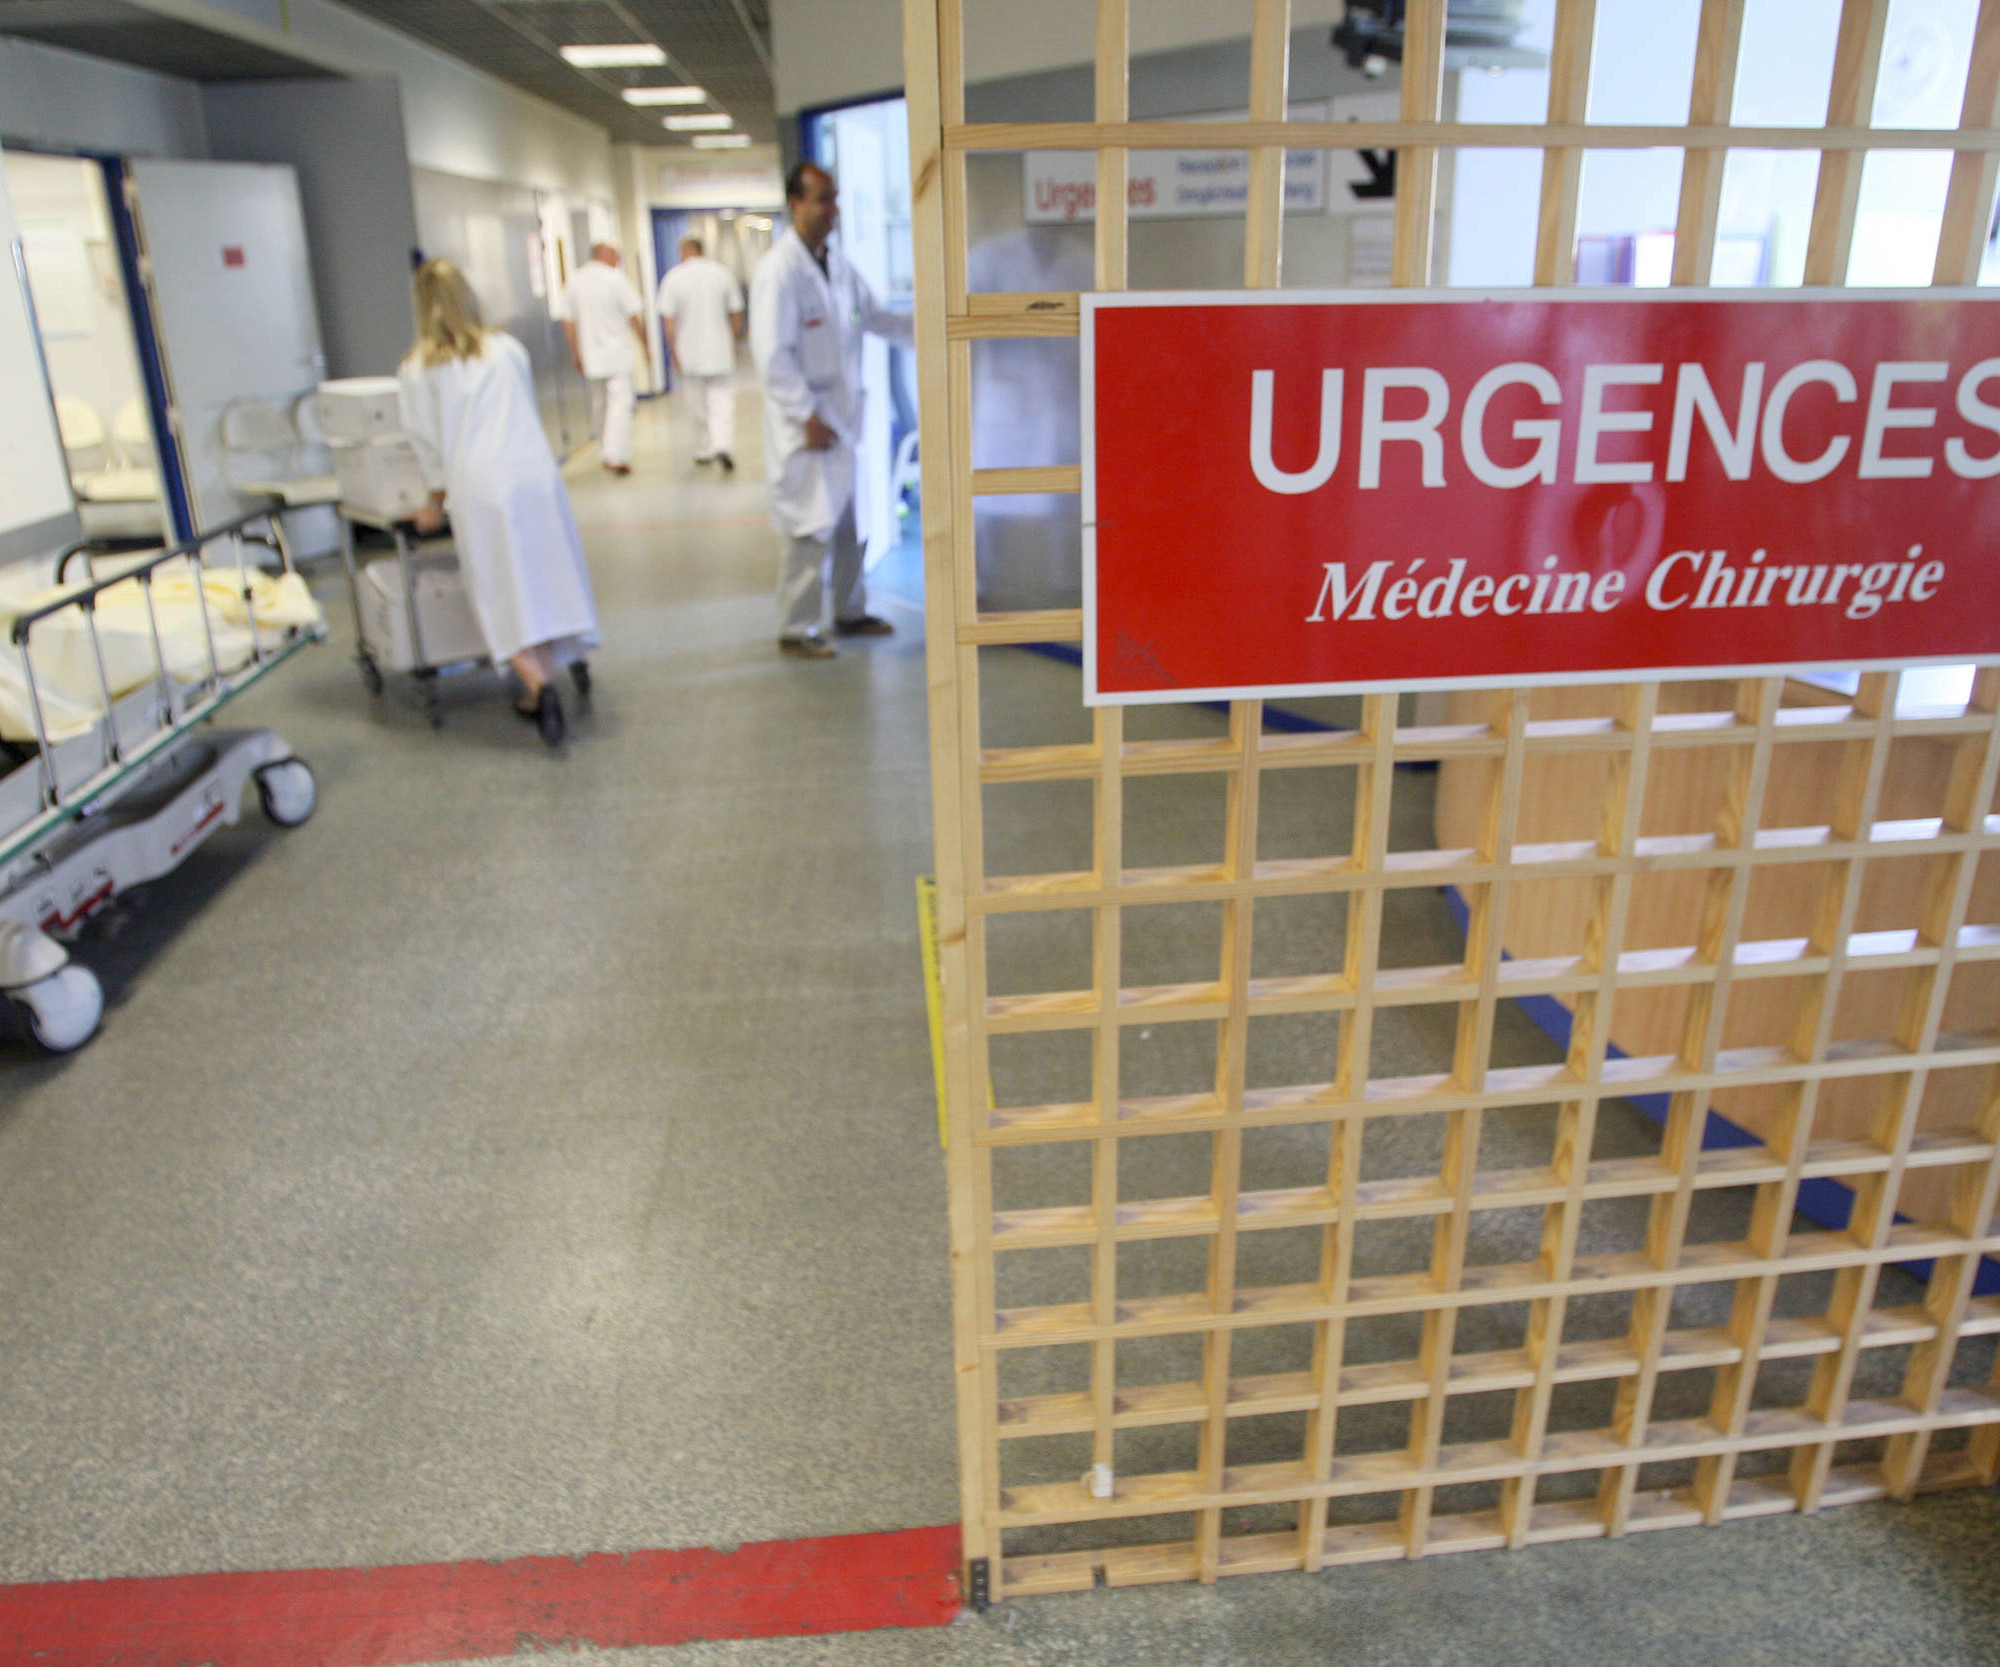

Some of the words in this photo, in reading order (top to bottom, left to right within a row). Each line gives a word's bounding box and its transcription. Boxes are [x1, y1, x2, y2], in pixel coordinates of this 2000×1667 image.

[1035, 178, 1156, 220] Urgees
[1249, 358, 2000, 494] URGENCES
[1305, 556, 1626, 622] Médecine
[1645, 544, 1945, 619] Chirurgie
